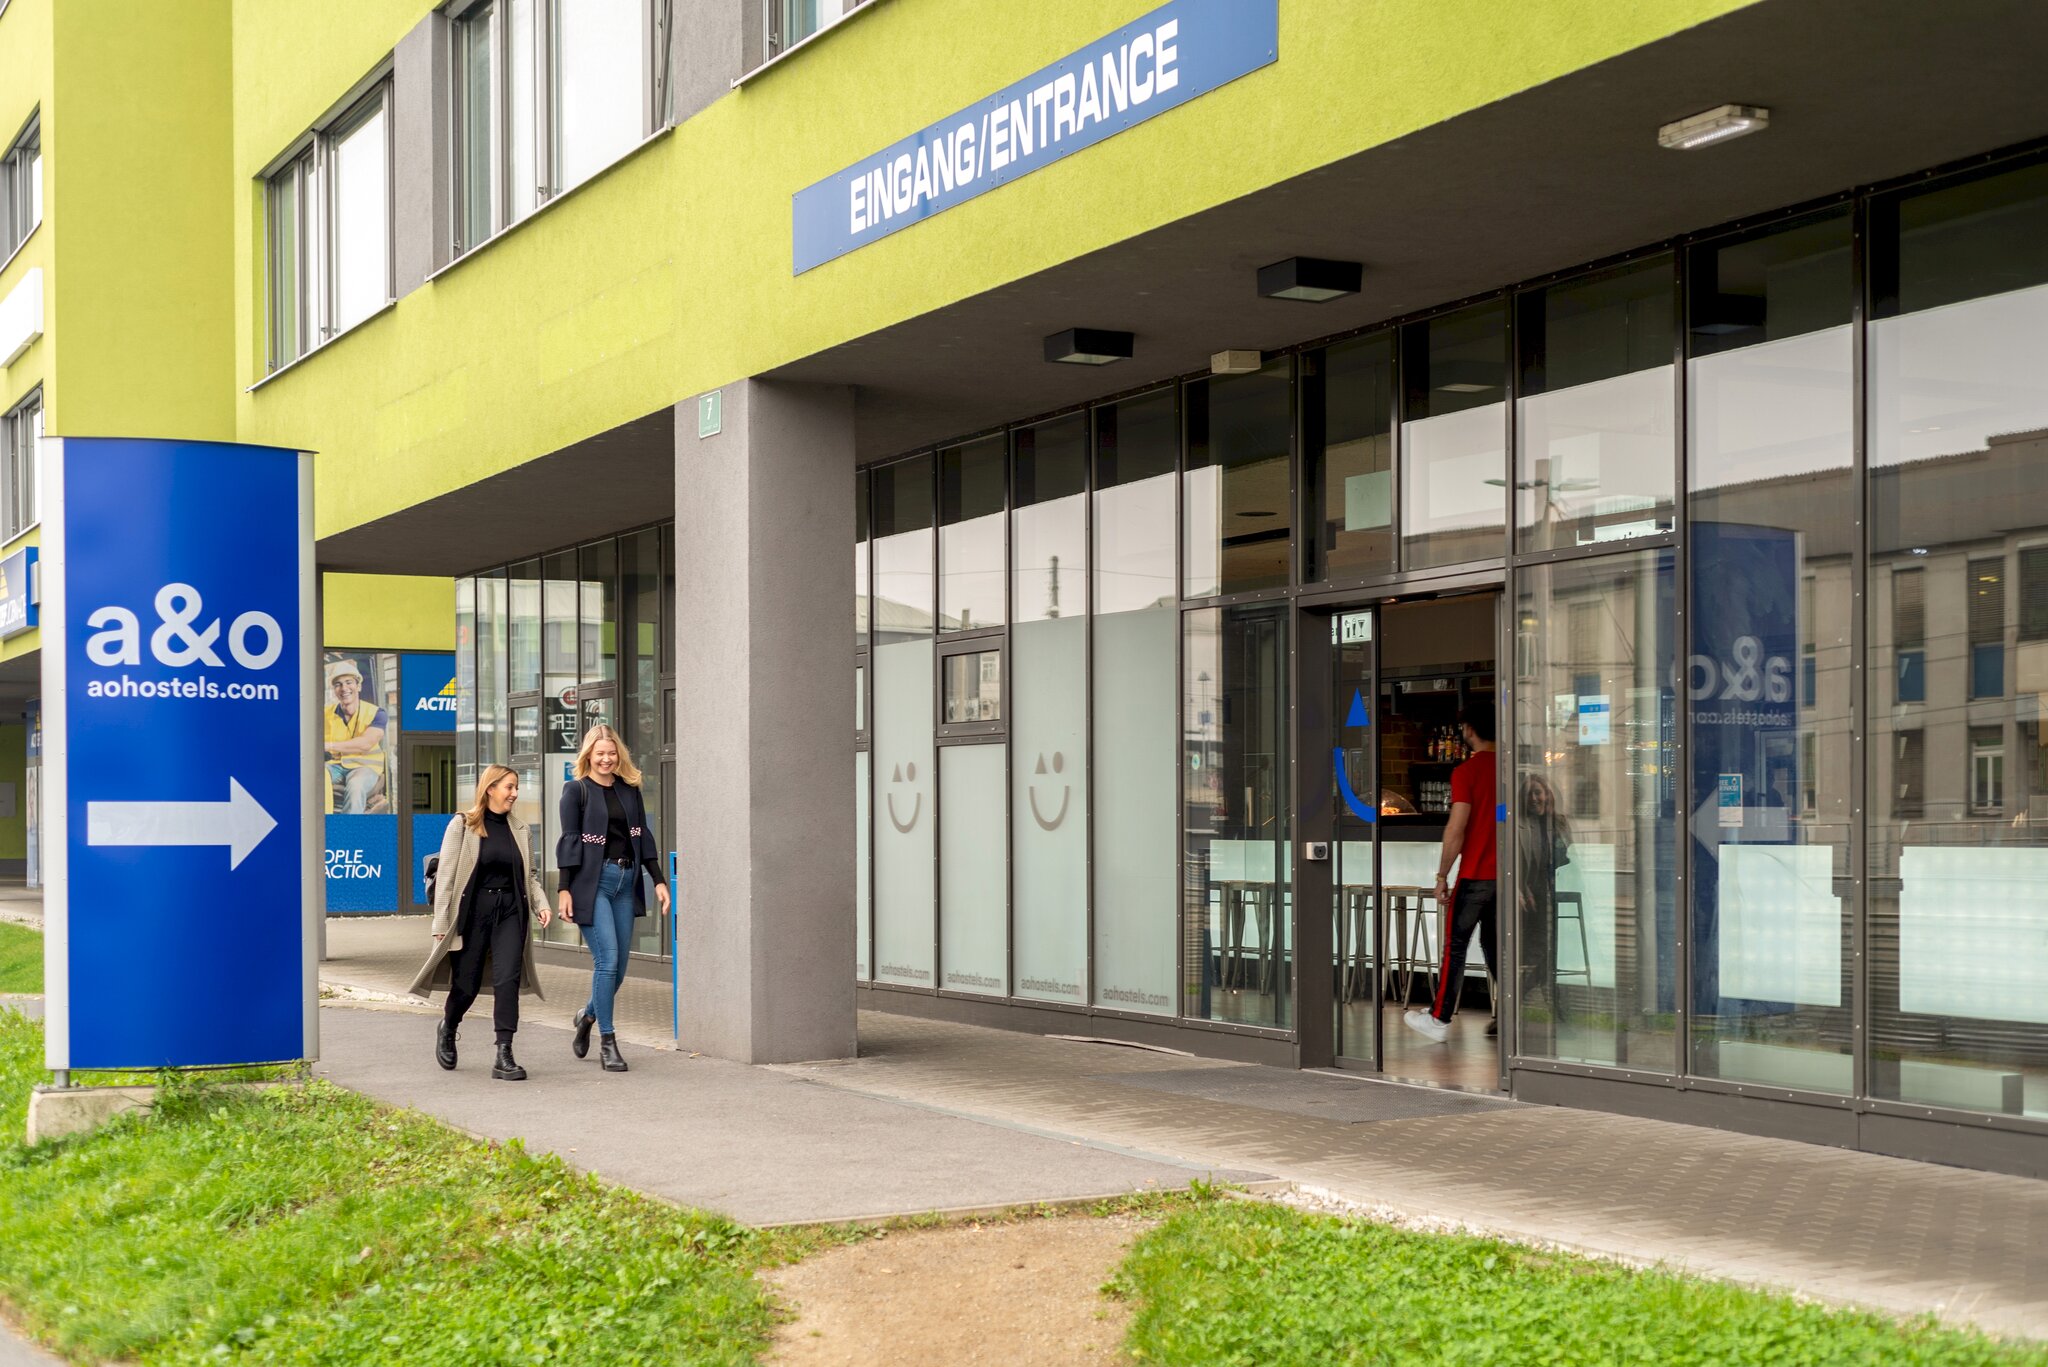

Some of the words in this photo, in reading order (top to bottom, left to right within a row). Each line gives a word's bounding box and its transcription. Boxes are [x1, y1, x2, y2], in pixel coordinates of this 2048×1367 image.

[850, 18, 1179, 235] EINGANG/ENTRANCE
[706, 397, 713, 420] 7
[86, 583, 282, 670] a&o
[87, 674, 279, 701] aohostels.com
[324, 864, 382, 879] ACTION
[880, 963, 930, 981] aohostels.com
[947, 971, 1001, 989] aohostels.com
[1020, 977, 1080, 996] aohostels.com
[1102, 986, 1169, 1007] aohostels.com
